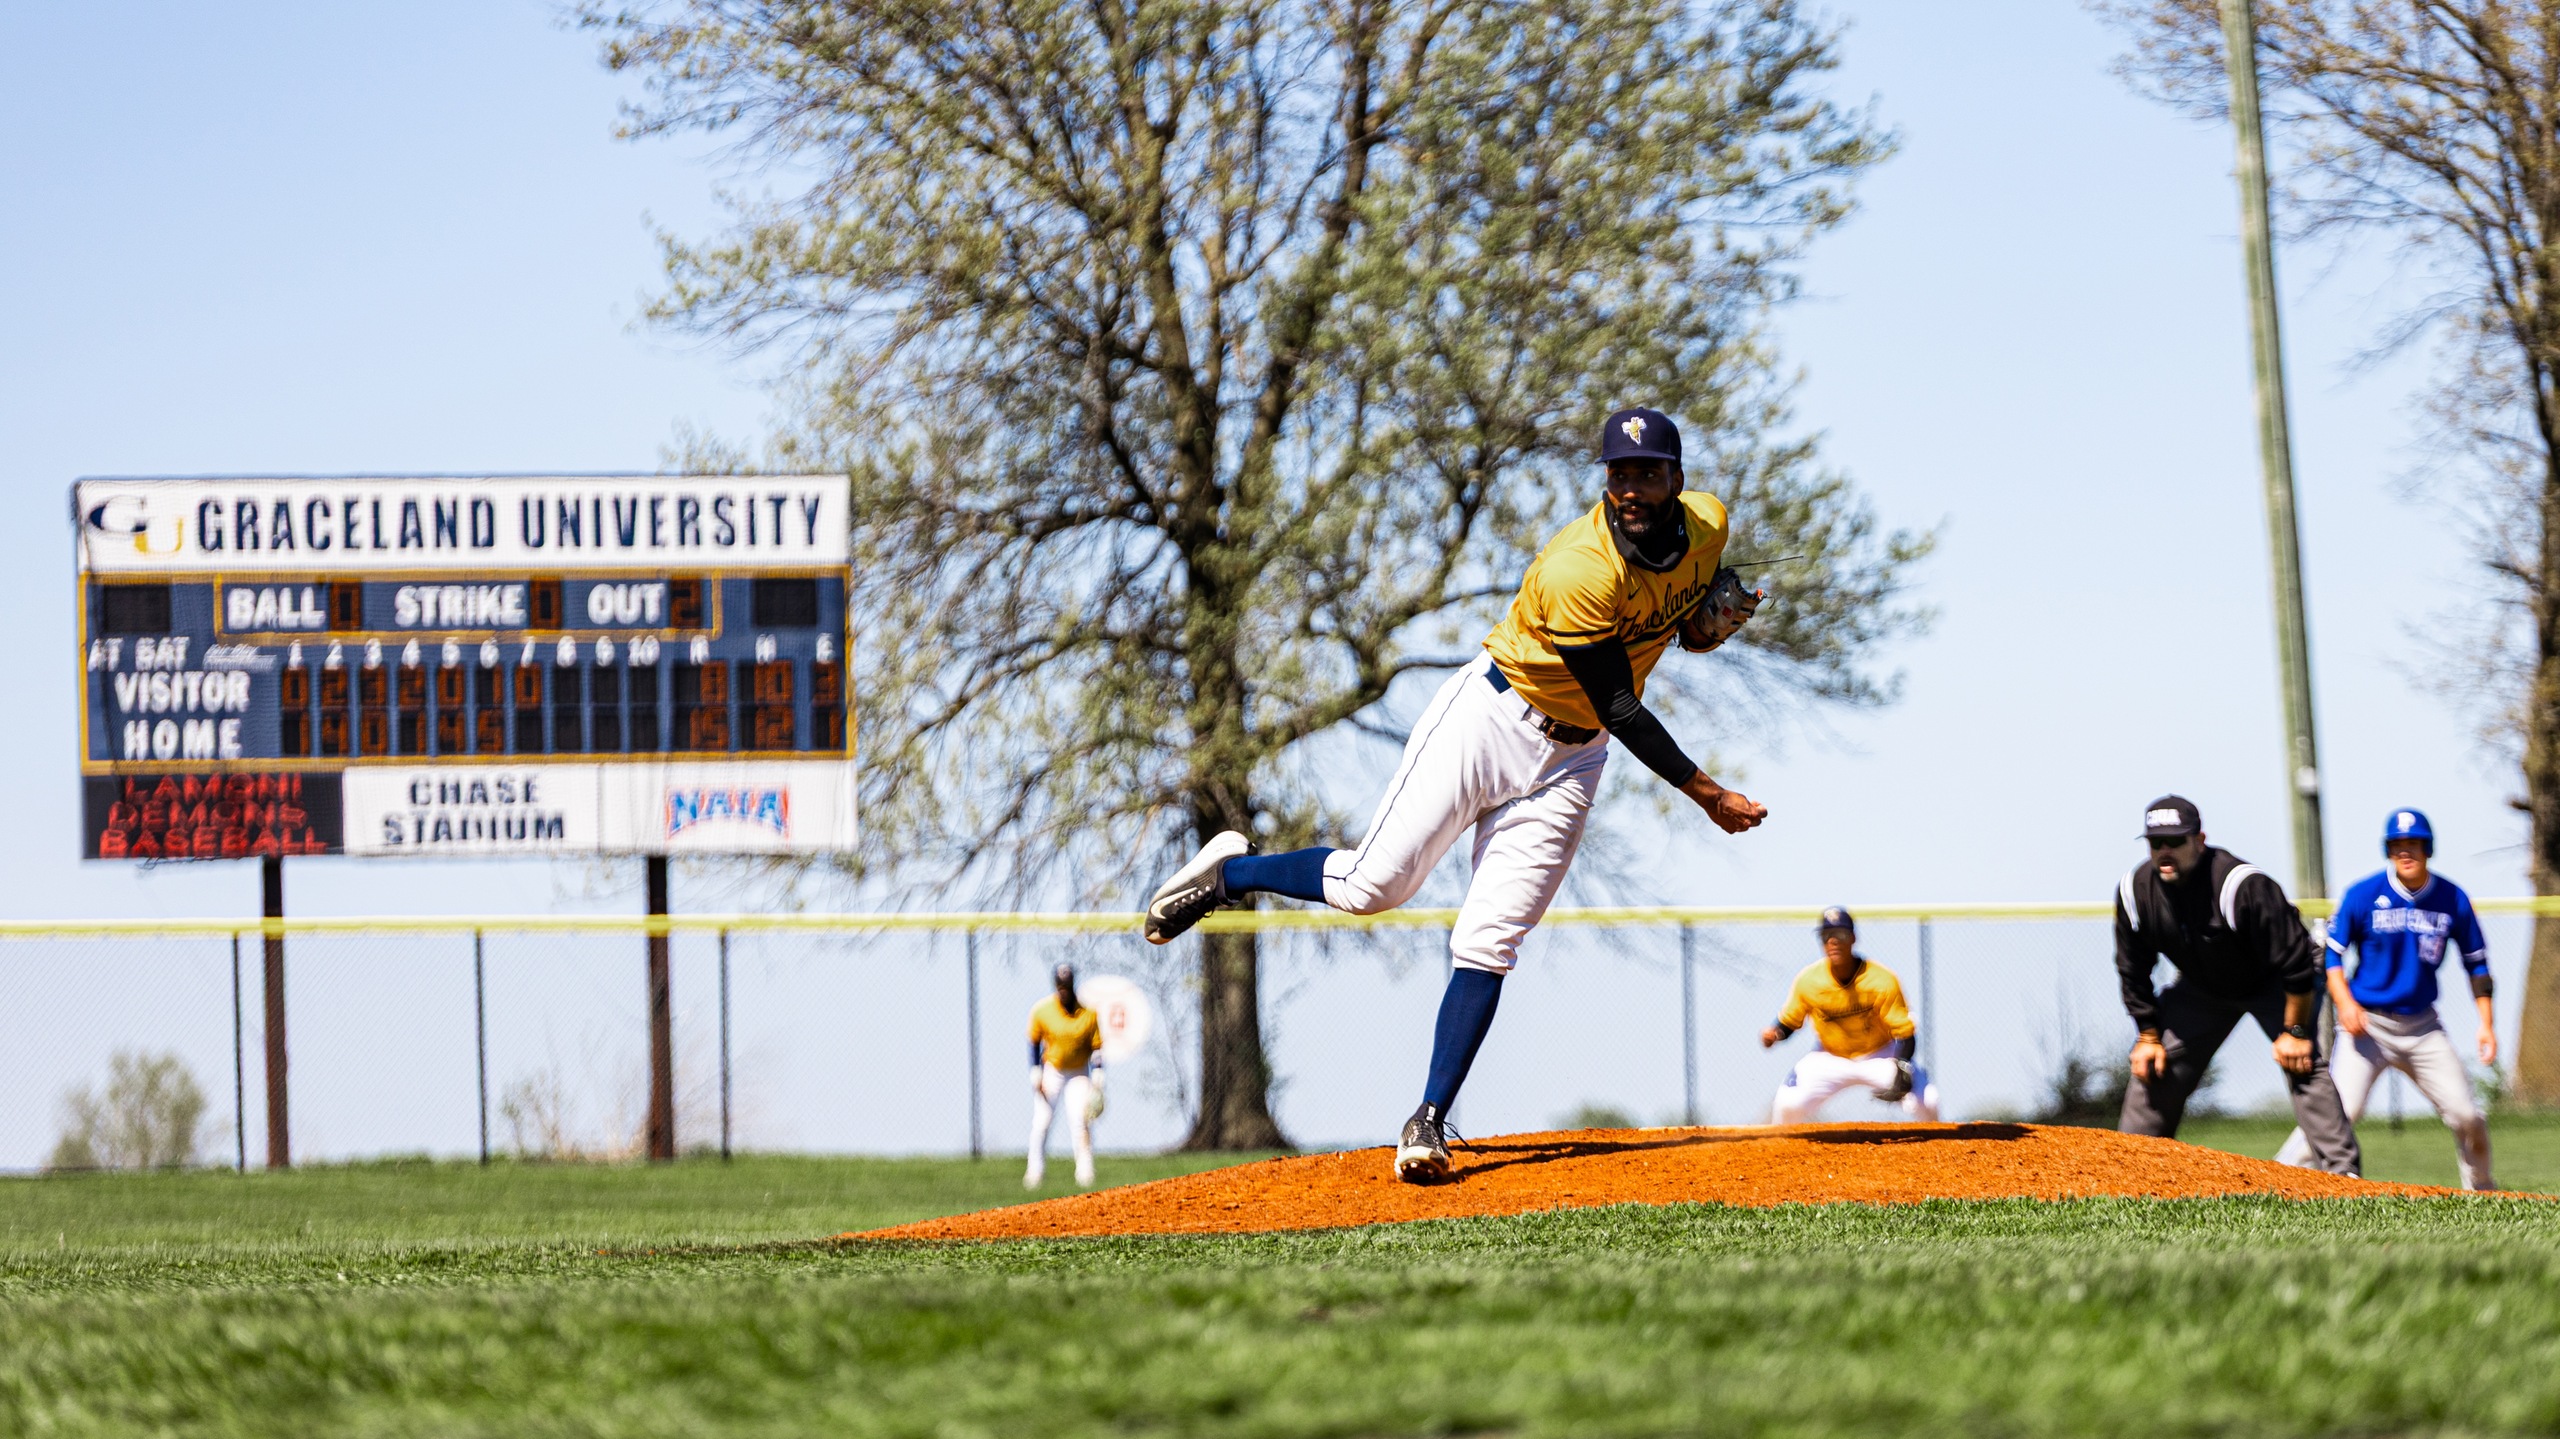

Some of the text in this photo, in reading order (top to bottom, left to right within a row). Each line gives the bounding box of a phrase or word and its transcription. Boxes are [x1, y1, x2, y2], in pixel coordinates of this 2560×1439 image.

[197, 491, 823, 550] GRACELAND UNIVERSITY
[227, 586, 326, 629] BALL
[394, 584, 527, 628] STRIKE
[587, 583, 666, 625] OUT
[88, 637, 124, 672] AT
[135, 636, 191, 671] BAT
[287, 638, 304, 671] 1
[325, 638, 344, 671] 2
[363, 637, 383, 670] 3
[401, 637, 421, 670] 4
[441, 636, 460, 669] 5
[479, 637, 499, 669] 6
[556, 635, 577, 668] 8
[628, 635, 660, 667] 10
[816, 633, 836, 664] E
[114, 671, 251, 714] VISITOR
[122, 718, 242, 760] HOME
[125, 772, 302, 803] LAMONI
[409, 773, 540, 805] CHASE
[108, 801, 307, 831] DEMONS
[383, 807, 565, 844] STADIUM
[667, 784, 790, 840] NAIA
[100, 827, 328, 858] BASEBALL
